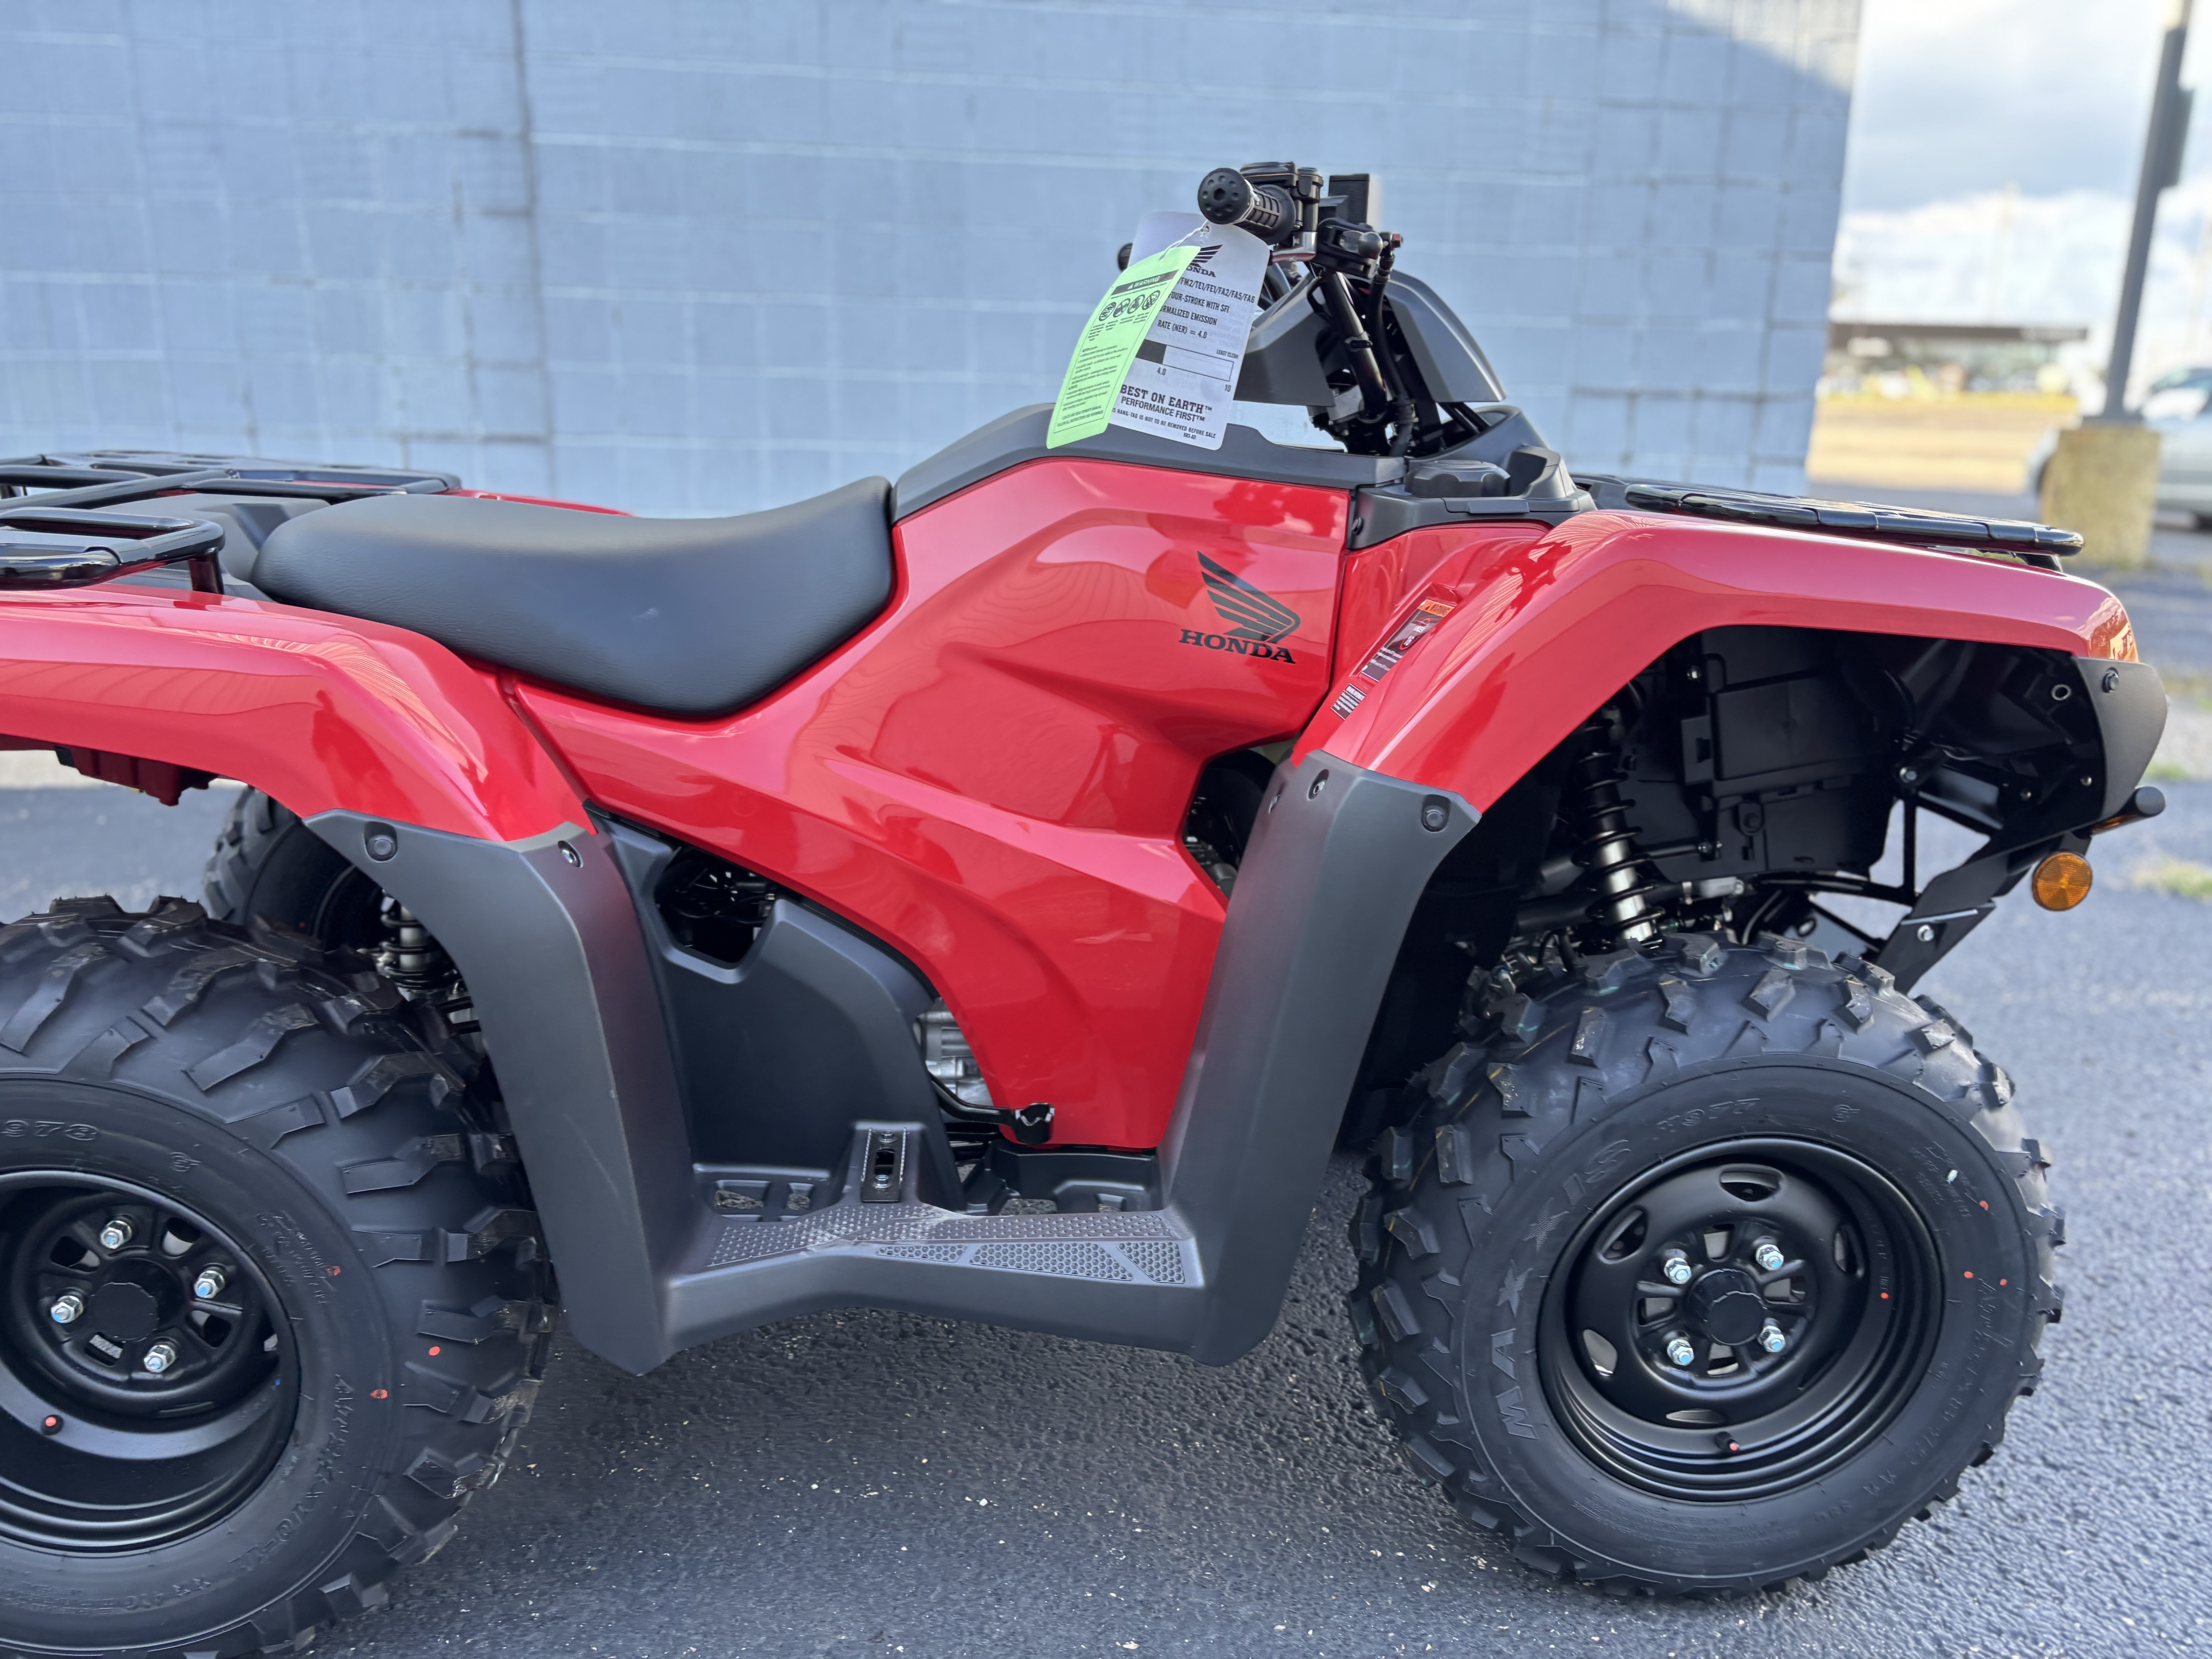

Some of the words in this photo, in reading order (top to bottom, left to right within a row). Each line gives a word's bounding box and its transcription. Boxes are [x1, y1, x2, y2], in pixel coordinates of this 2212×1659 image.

[1186, 265, 1216, 278] ONDA
[1160, 305, 1190, 318] RMALIZED
[1191, 312, 1218, 326] EMISSION
[1206, 300, 1220, 311] WITH
[1221, 304, 1230, 313] SFI
[1157, 319, 1171, 330] RATE
[1172, 323, 1188, 335] (NER)
[1198, 330, 1207, 339] 4.0
[1157, 367, 1166, 376] 4.0
[1224, 384, 1231, 392] 10
[1120, 384, 1148, 399] BEST
[1151, 392, 1166, 404] ON
[1121, 396, 1175, 417] PERFORMANCE
[1167, 421, 1187, 431] REMOVED
[1188, 426, 1204, 436] BEFORE
[1178, 628, 1296, 665] HONDA
